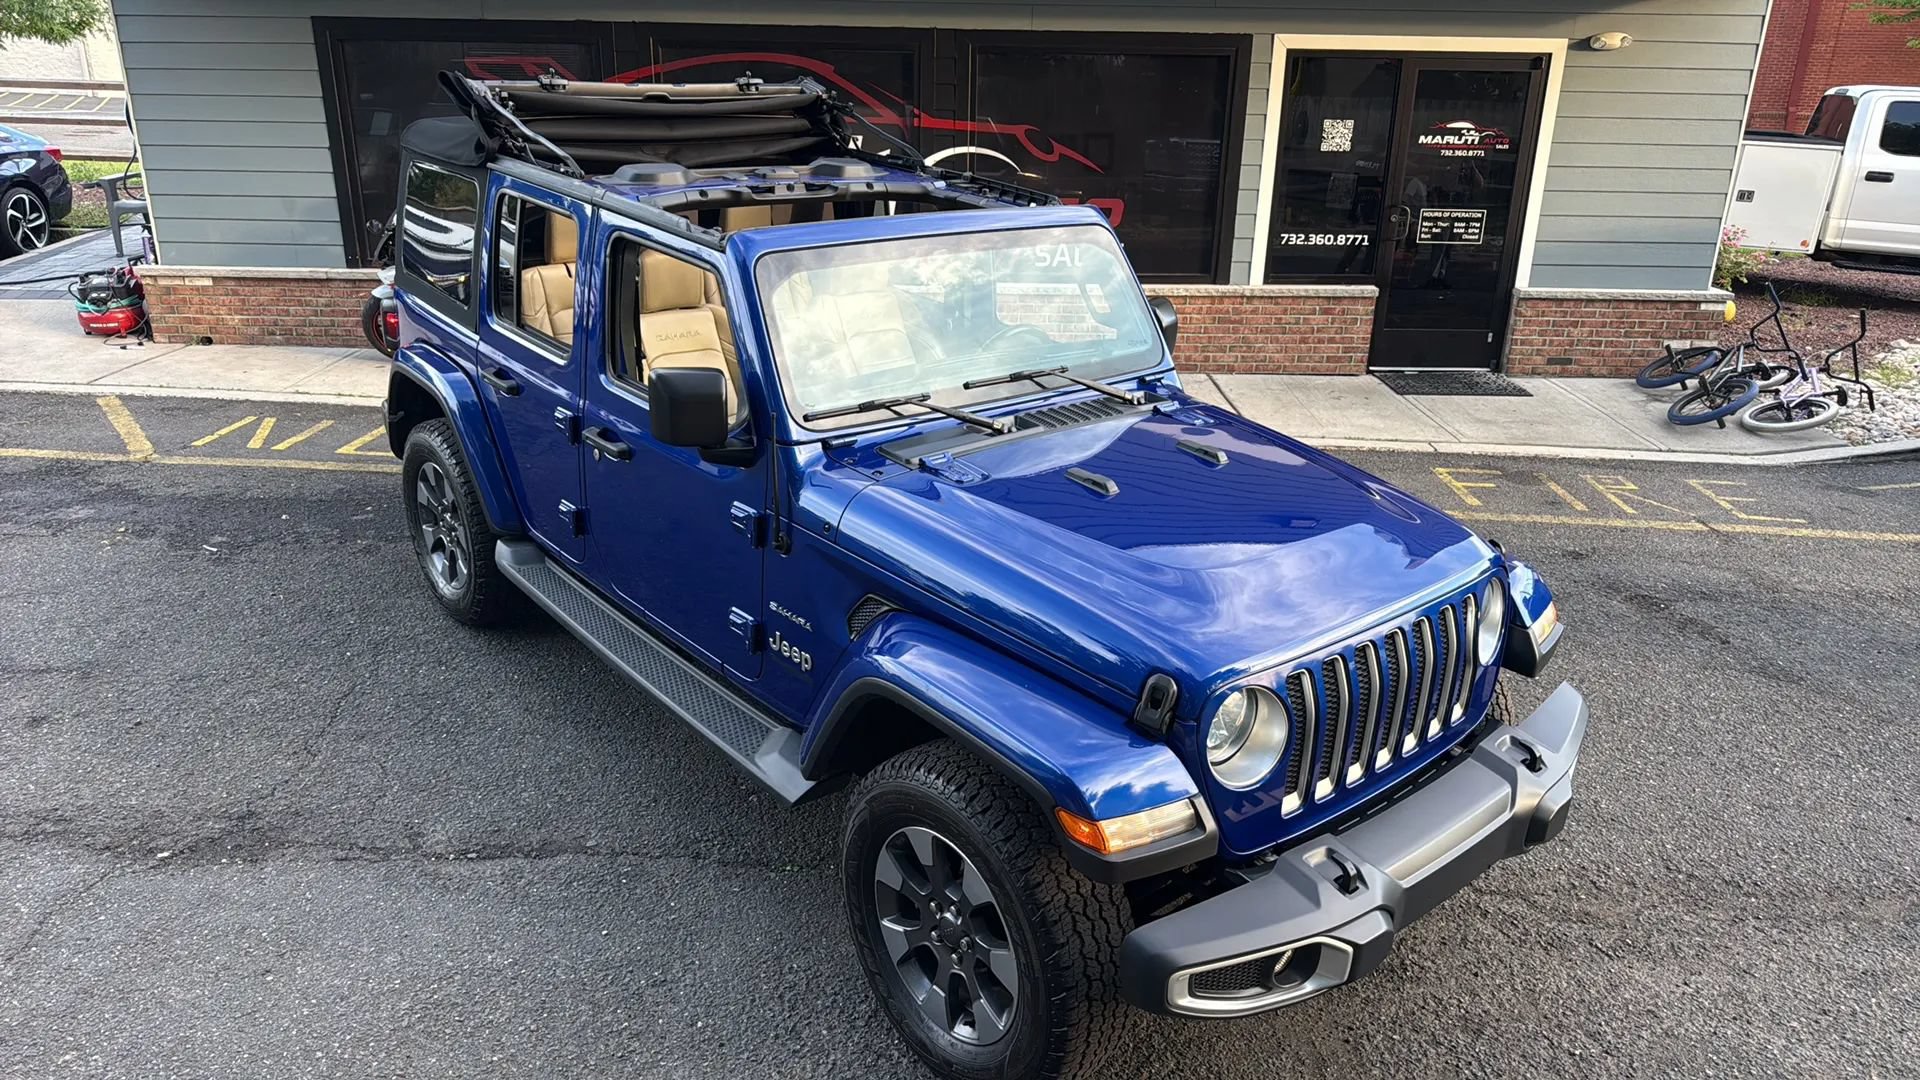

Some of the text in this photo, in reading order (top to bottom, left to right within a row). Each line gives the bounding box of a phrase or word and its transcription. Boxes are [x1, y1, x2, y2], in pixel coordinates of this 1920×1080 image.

[1418, 135, 1480, 144] MARUTI
[1440, 149, 1485, 157] 732.360.8771
[1280, 233, 1370, 246] 732.360.8771
[1432, 466, 1808, 524] FIRE
[768, 601, 813, 632] SAHARA
[768, 630, 813, 673] Jeep
